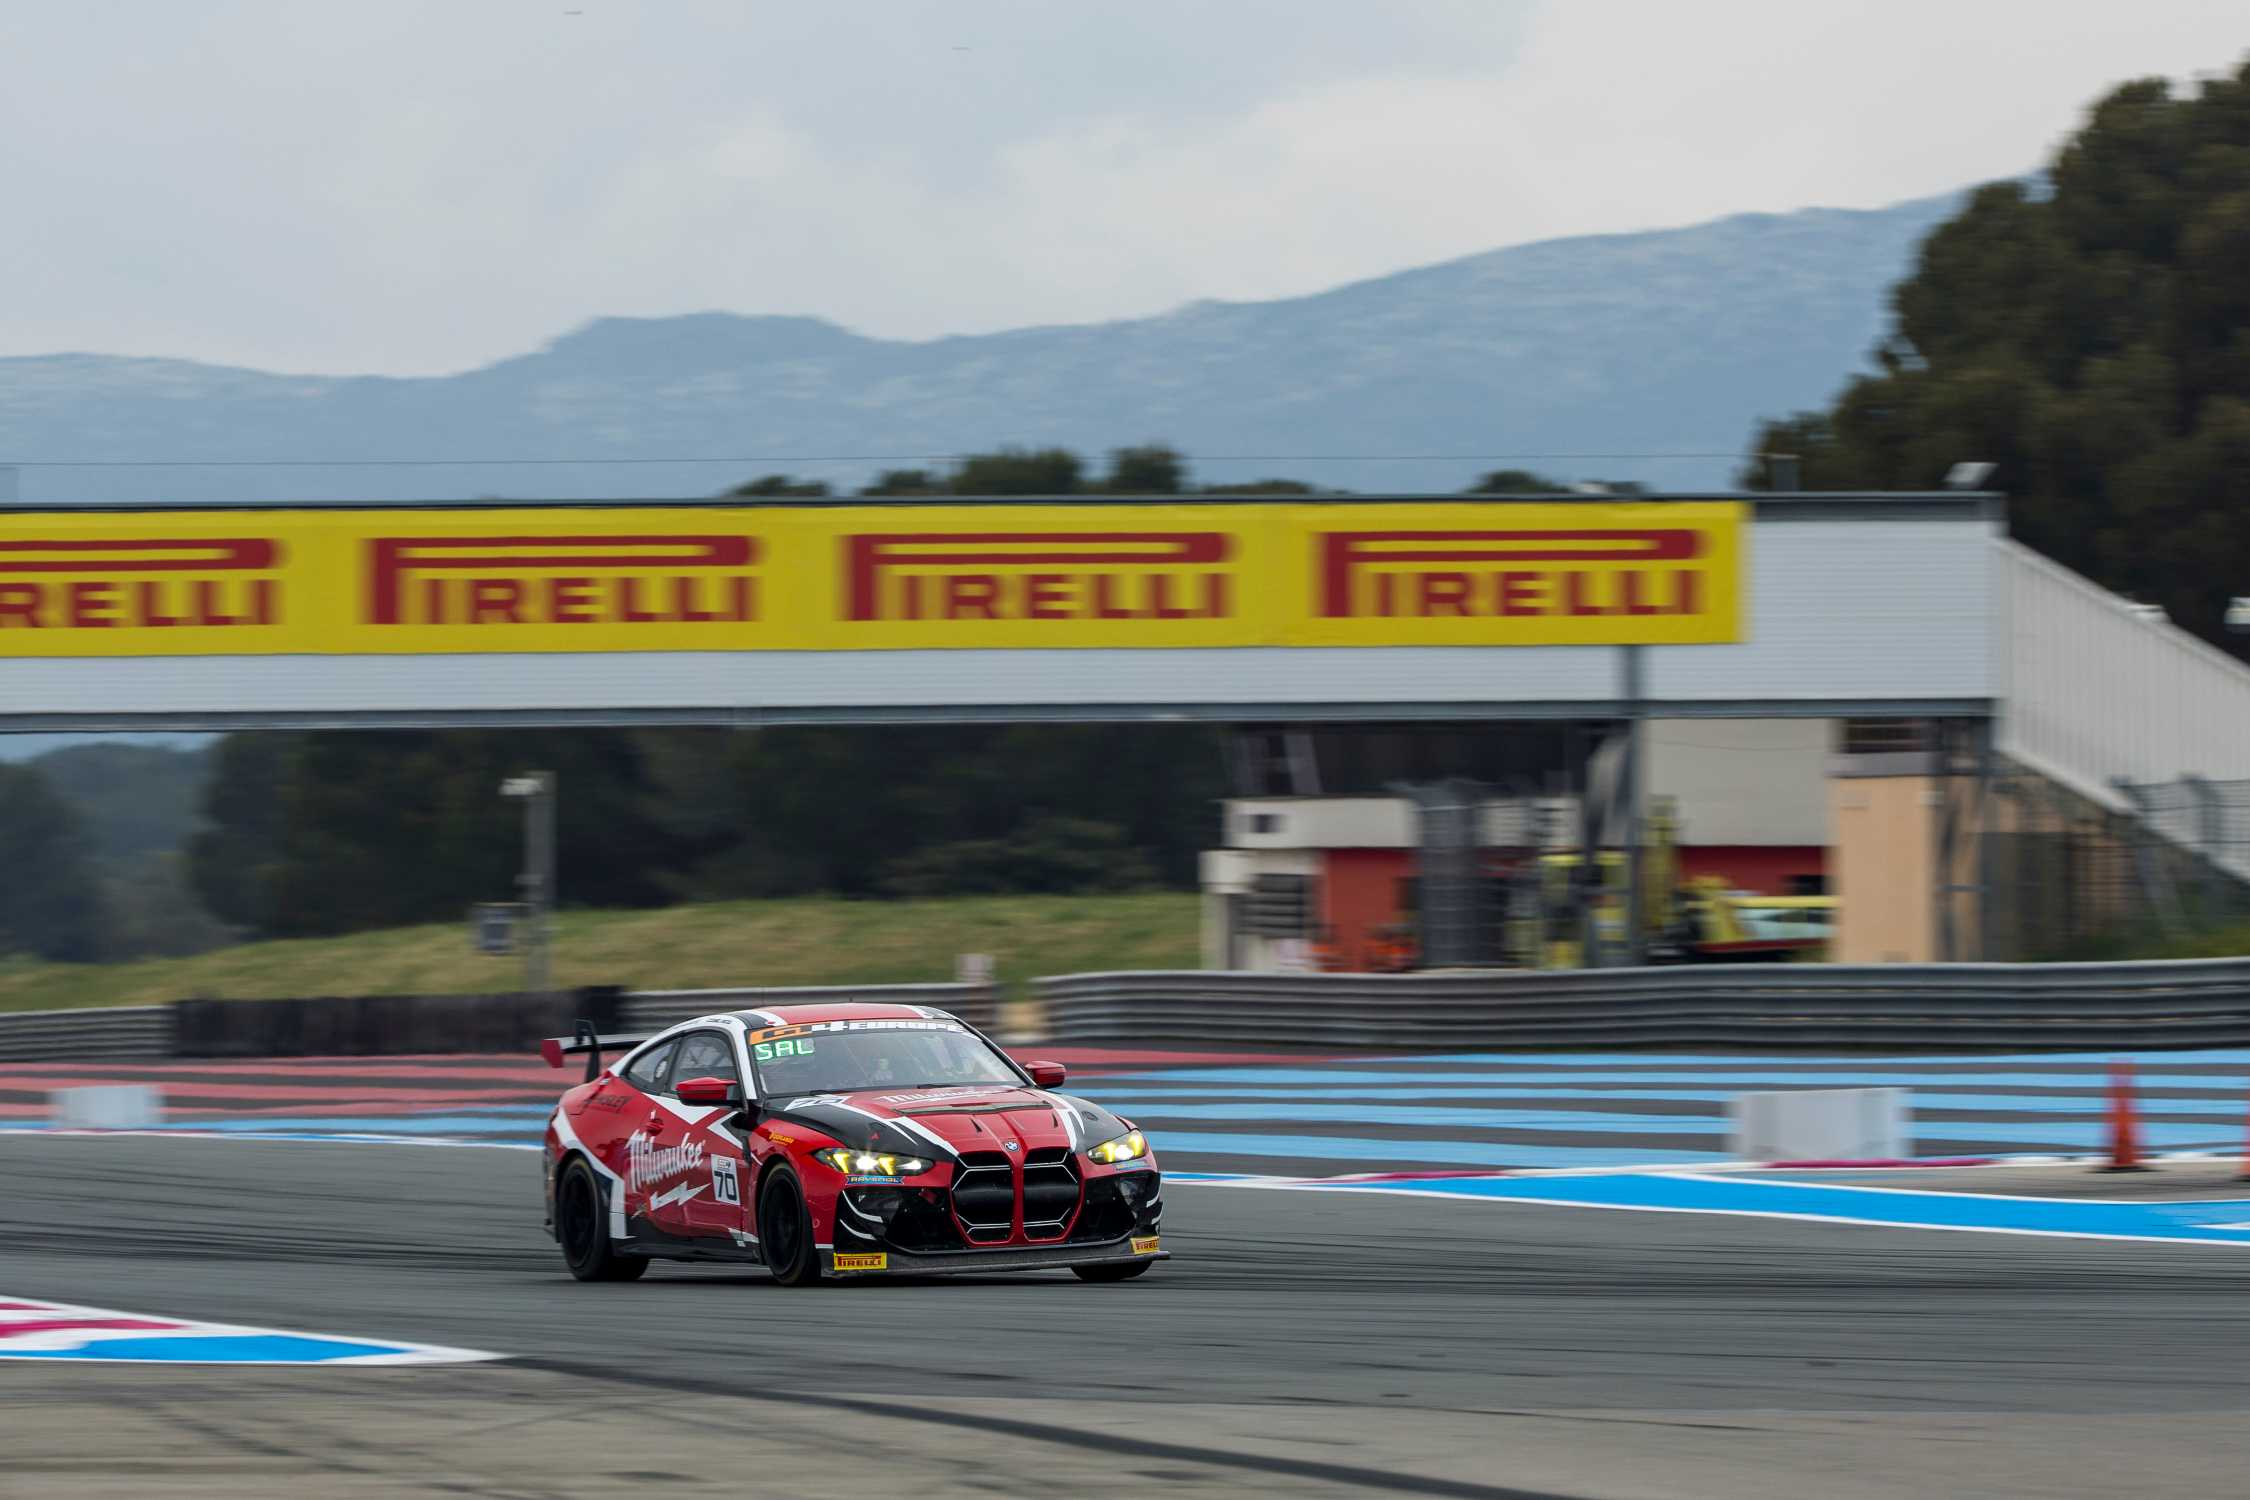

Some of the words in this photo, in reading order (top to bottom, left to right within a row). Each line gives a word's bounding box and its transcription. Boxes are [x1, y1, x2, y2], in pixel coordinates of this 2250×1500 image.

[366, 535, 757, 624] PIRELLI
[842, 532, 1234, 621] PIRELLI
[1317, 529, 1706, 617] PIRELLI
[754, 1040, 816, 1061] SAL
[624, 1109, 706, 1194] Milwaukee
[713, 1170, 738, 1201] 70
[837, 1255, 882, 1267] PIRELLI
